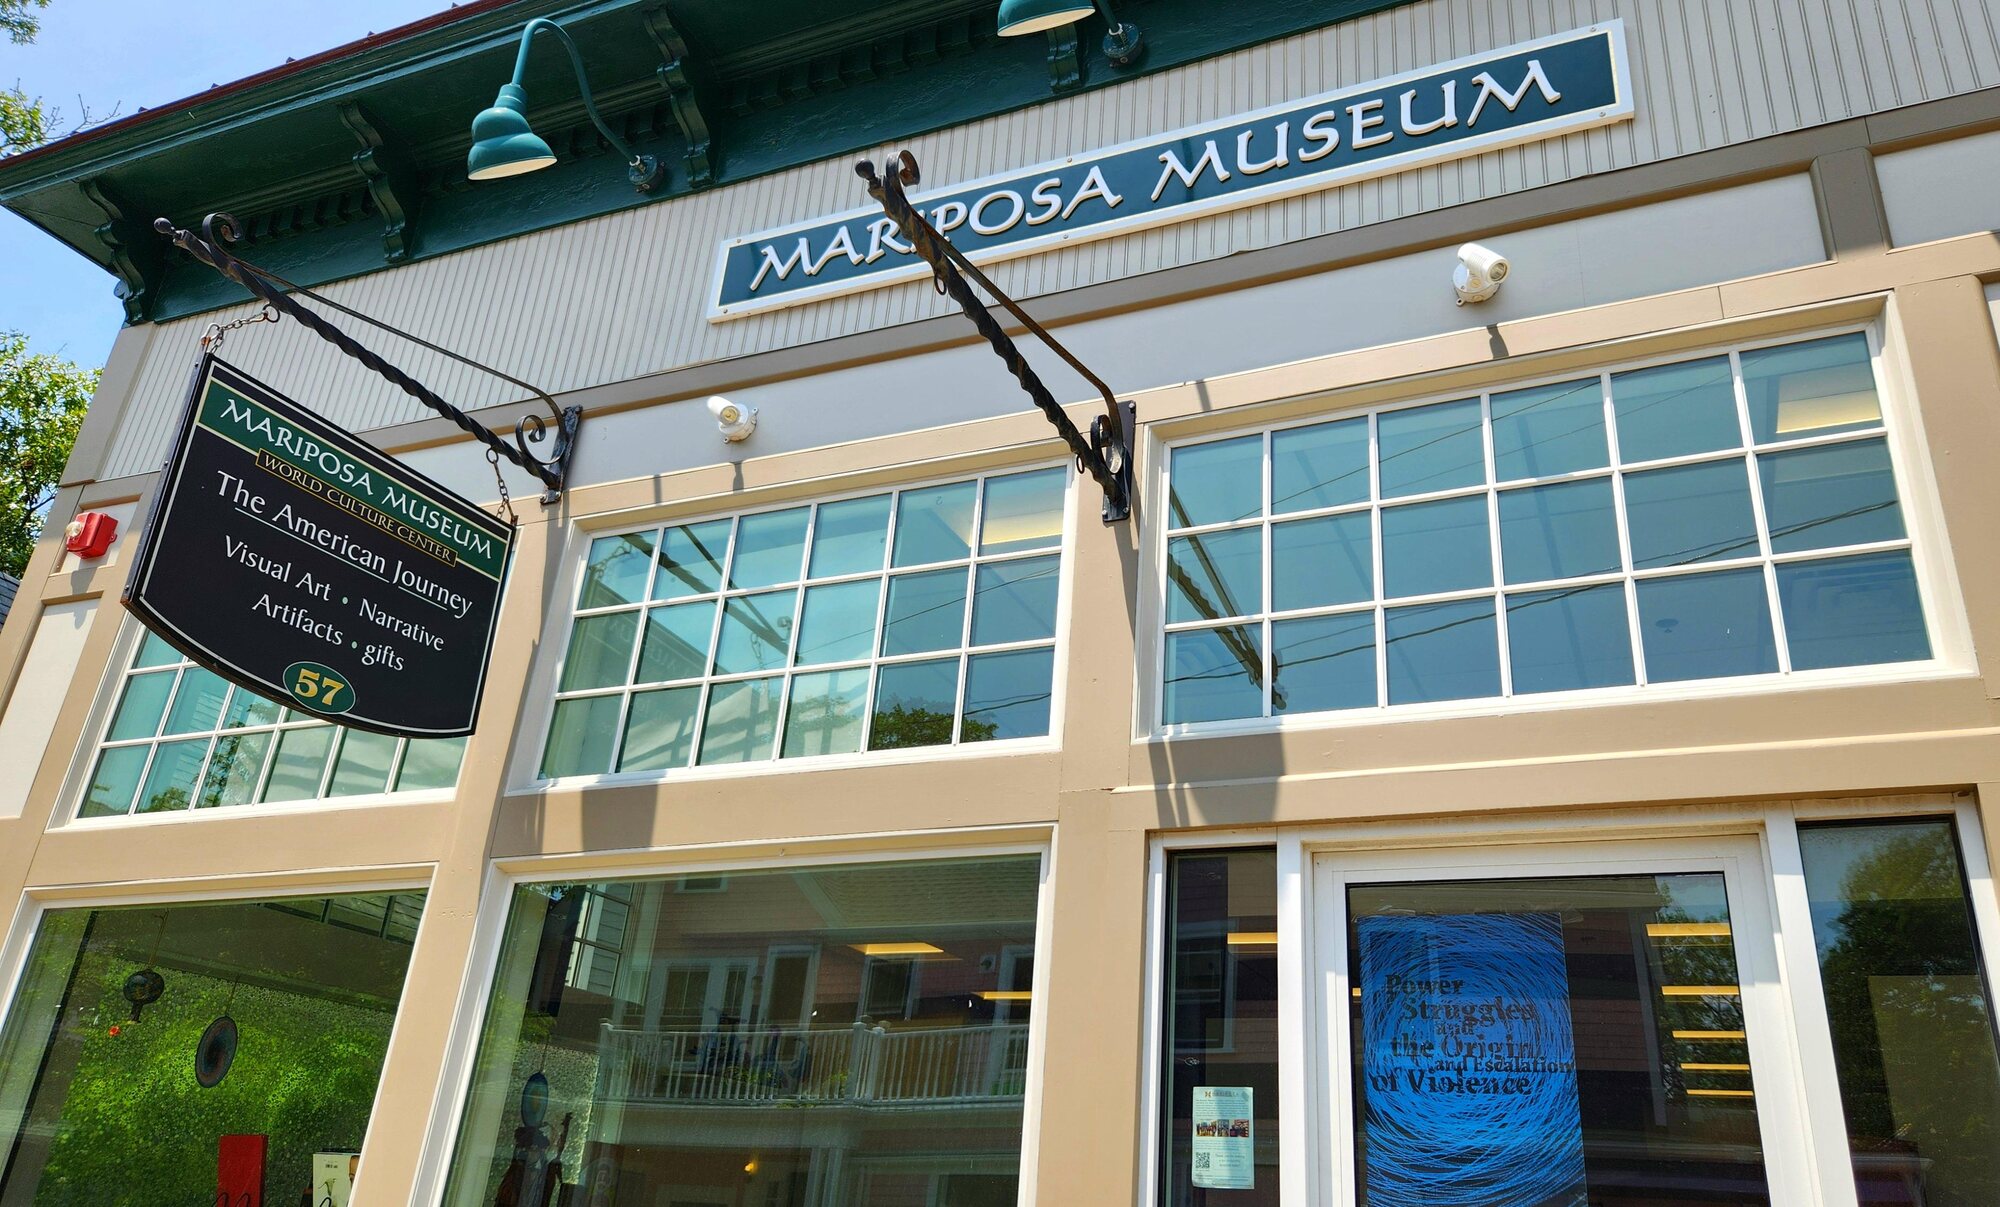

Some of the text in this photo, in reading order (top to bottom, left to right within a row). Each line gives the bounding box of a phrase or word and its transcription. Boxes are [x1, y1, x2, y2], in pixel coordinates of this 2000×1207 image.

[750, 59, 1561, 291] MARPOSA MUSEUM
[220, 398, 492, 560] MARIPOSA MUSEUM
[264, 454, 451, 562] WORLD CULTURE CENTER
[217, 470, 473, 619] The American Journey
[225, 535, 445, 651] Visual Art Narrative
[252, 593, 404, 671] Artifacts gifts
[295, 668, 345, 706] 57
[1385, 974, 1464, 995] Power
[1368, 1066, 1533, 1095] of Violence
[1390, 1033, 1536, 1059] the Origin
[1434, 1056, 1574, 1074] and Escalation
